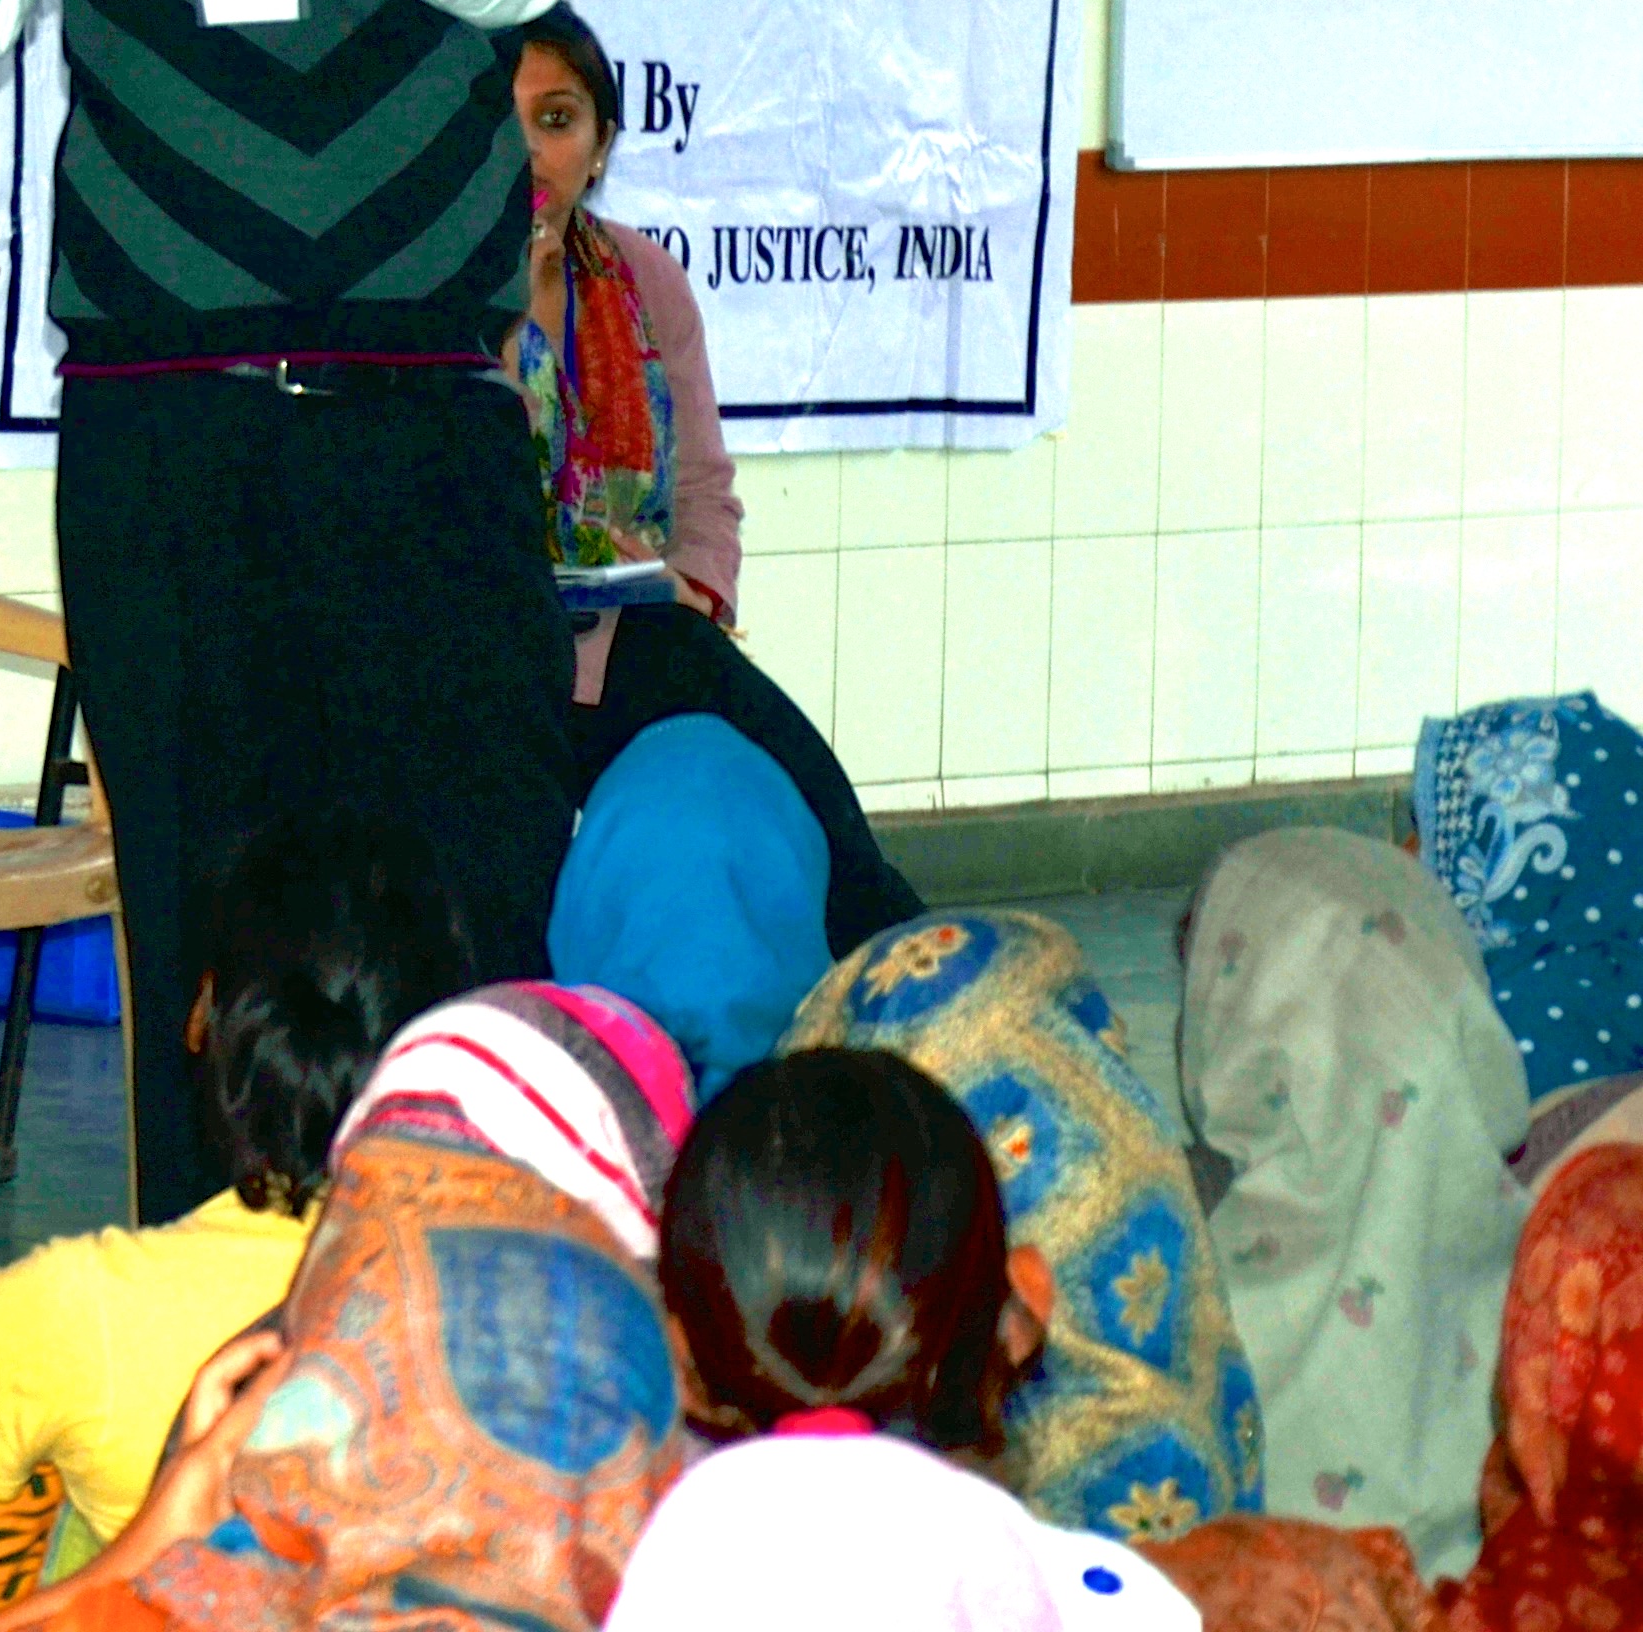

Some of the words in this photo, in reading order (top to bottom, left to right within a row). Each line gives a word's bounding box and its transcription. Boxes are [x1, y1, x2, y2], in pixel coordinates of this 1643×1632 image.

[641, 60, 701, 154] By
[707, 225, 877, 293] JUSTICE,
[894, 225, 994, 282] INDIA
